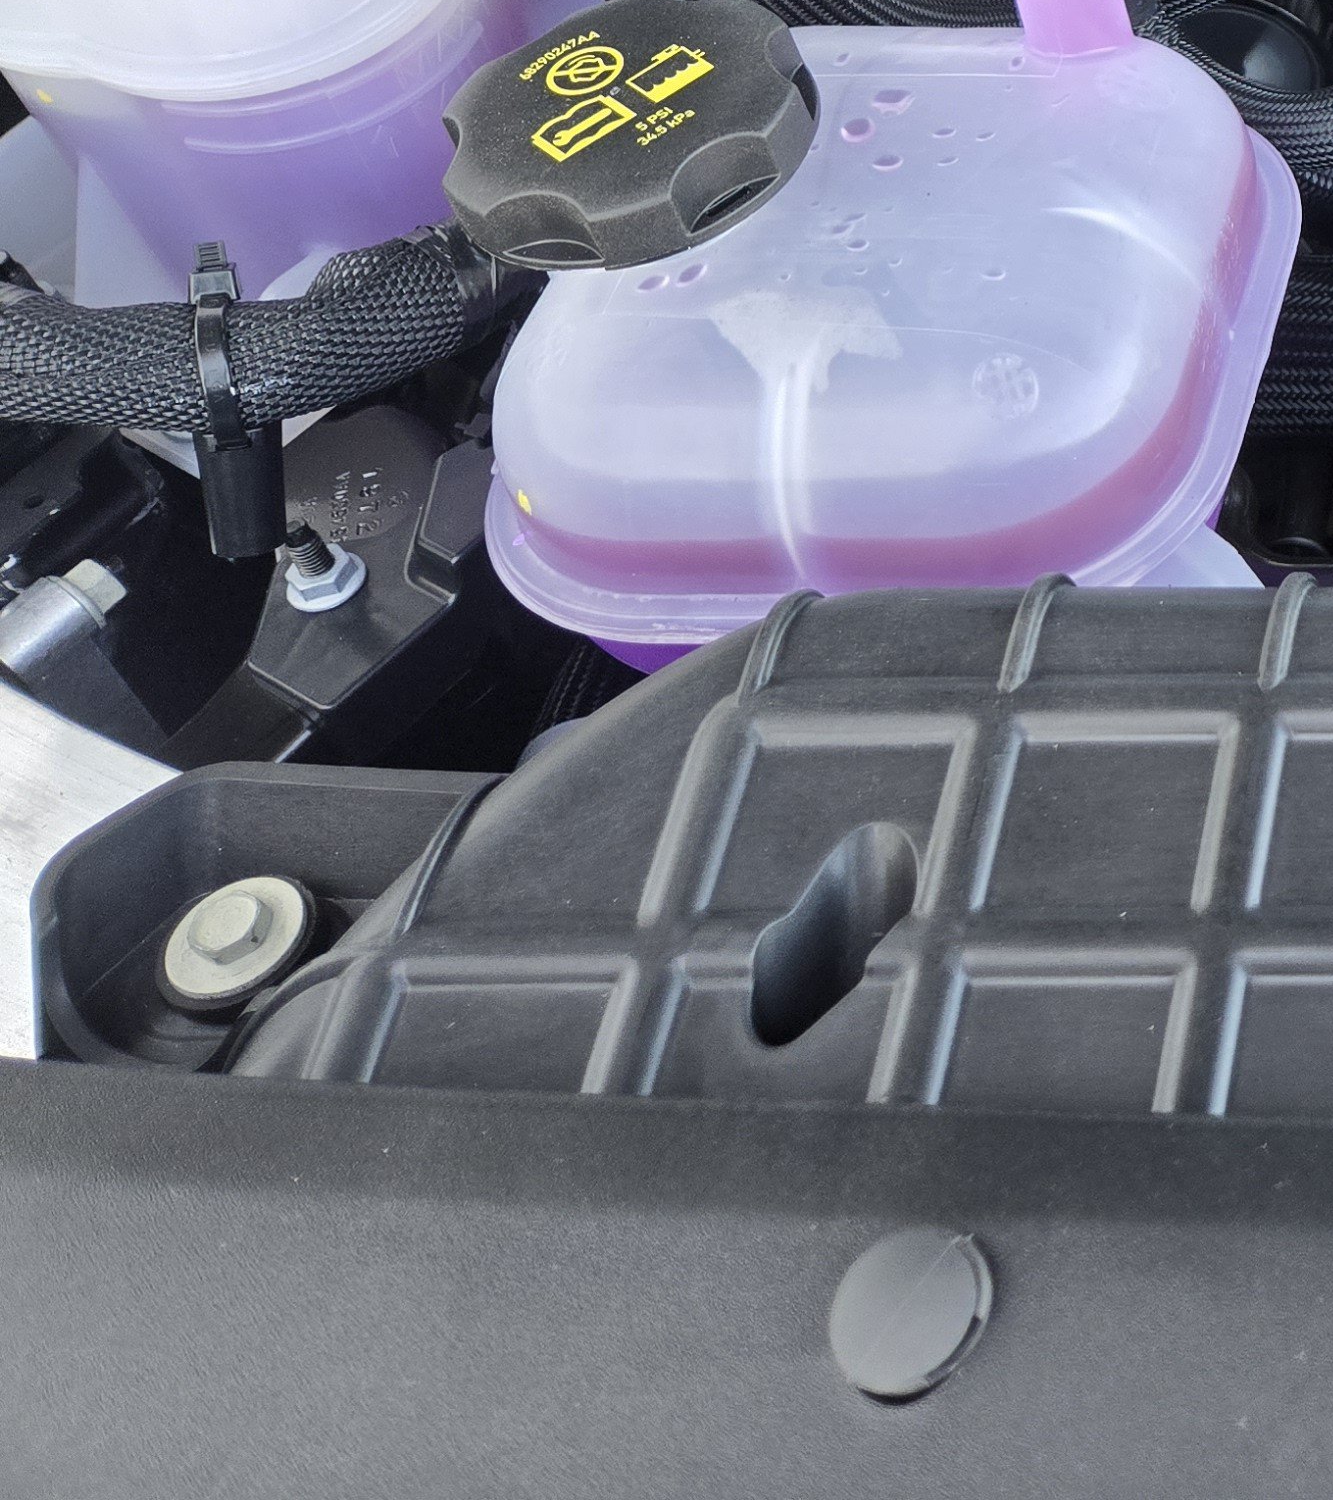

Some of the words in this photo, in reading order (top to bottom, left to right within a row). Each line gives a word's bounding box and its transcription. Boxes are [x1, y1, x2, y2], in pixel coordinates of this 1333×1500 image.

[518, 29, 601, 82] 68290247AA
[634, 120, 649, 132] 5
[645, 106, 674, 124] PSI
[636, 125, 668, 147] 34.5
[666, 109, 697, 129] kPa
